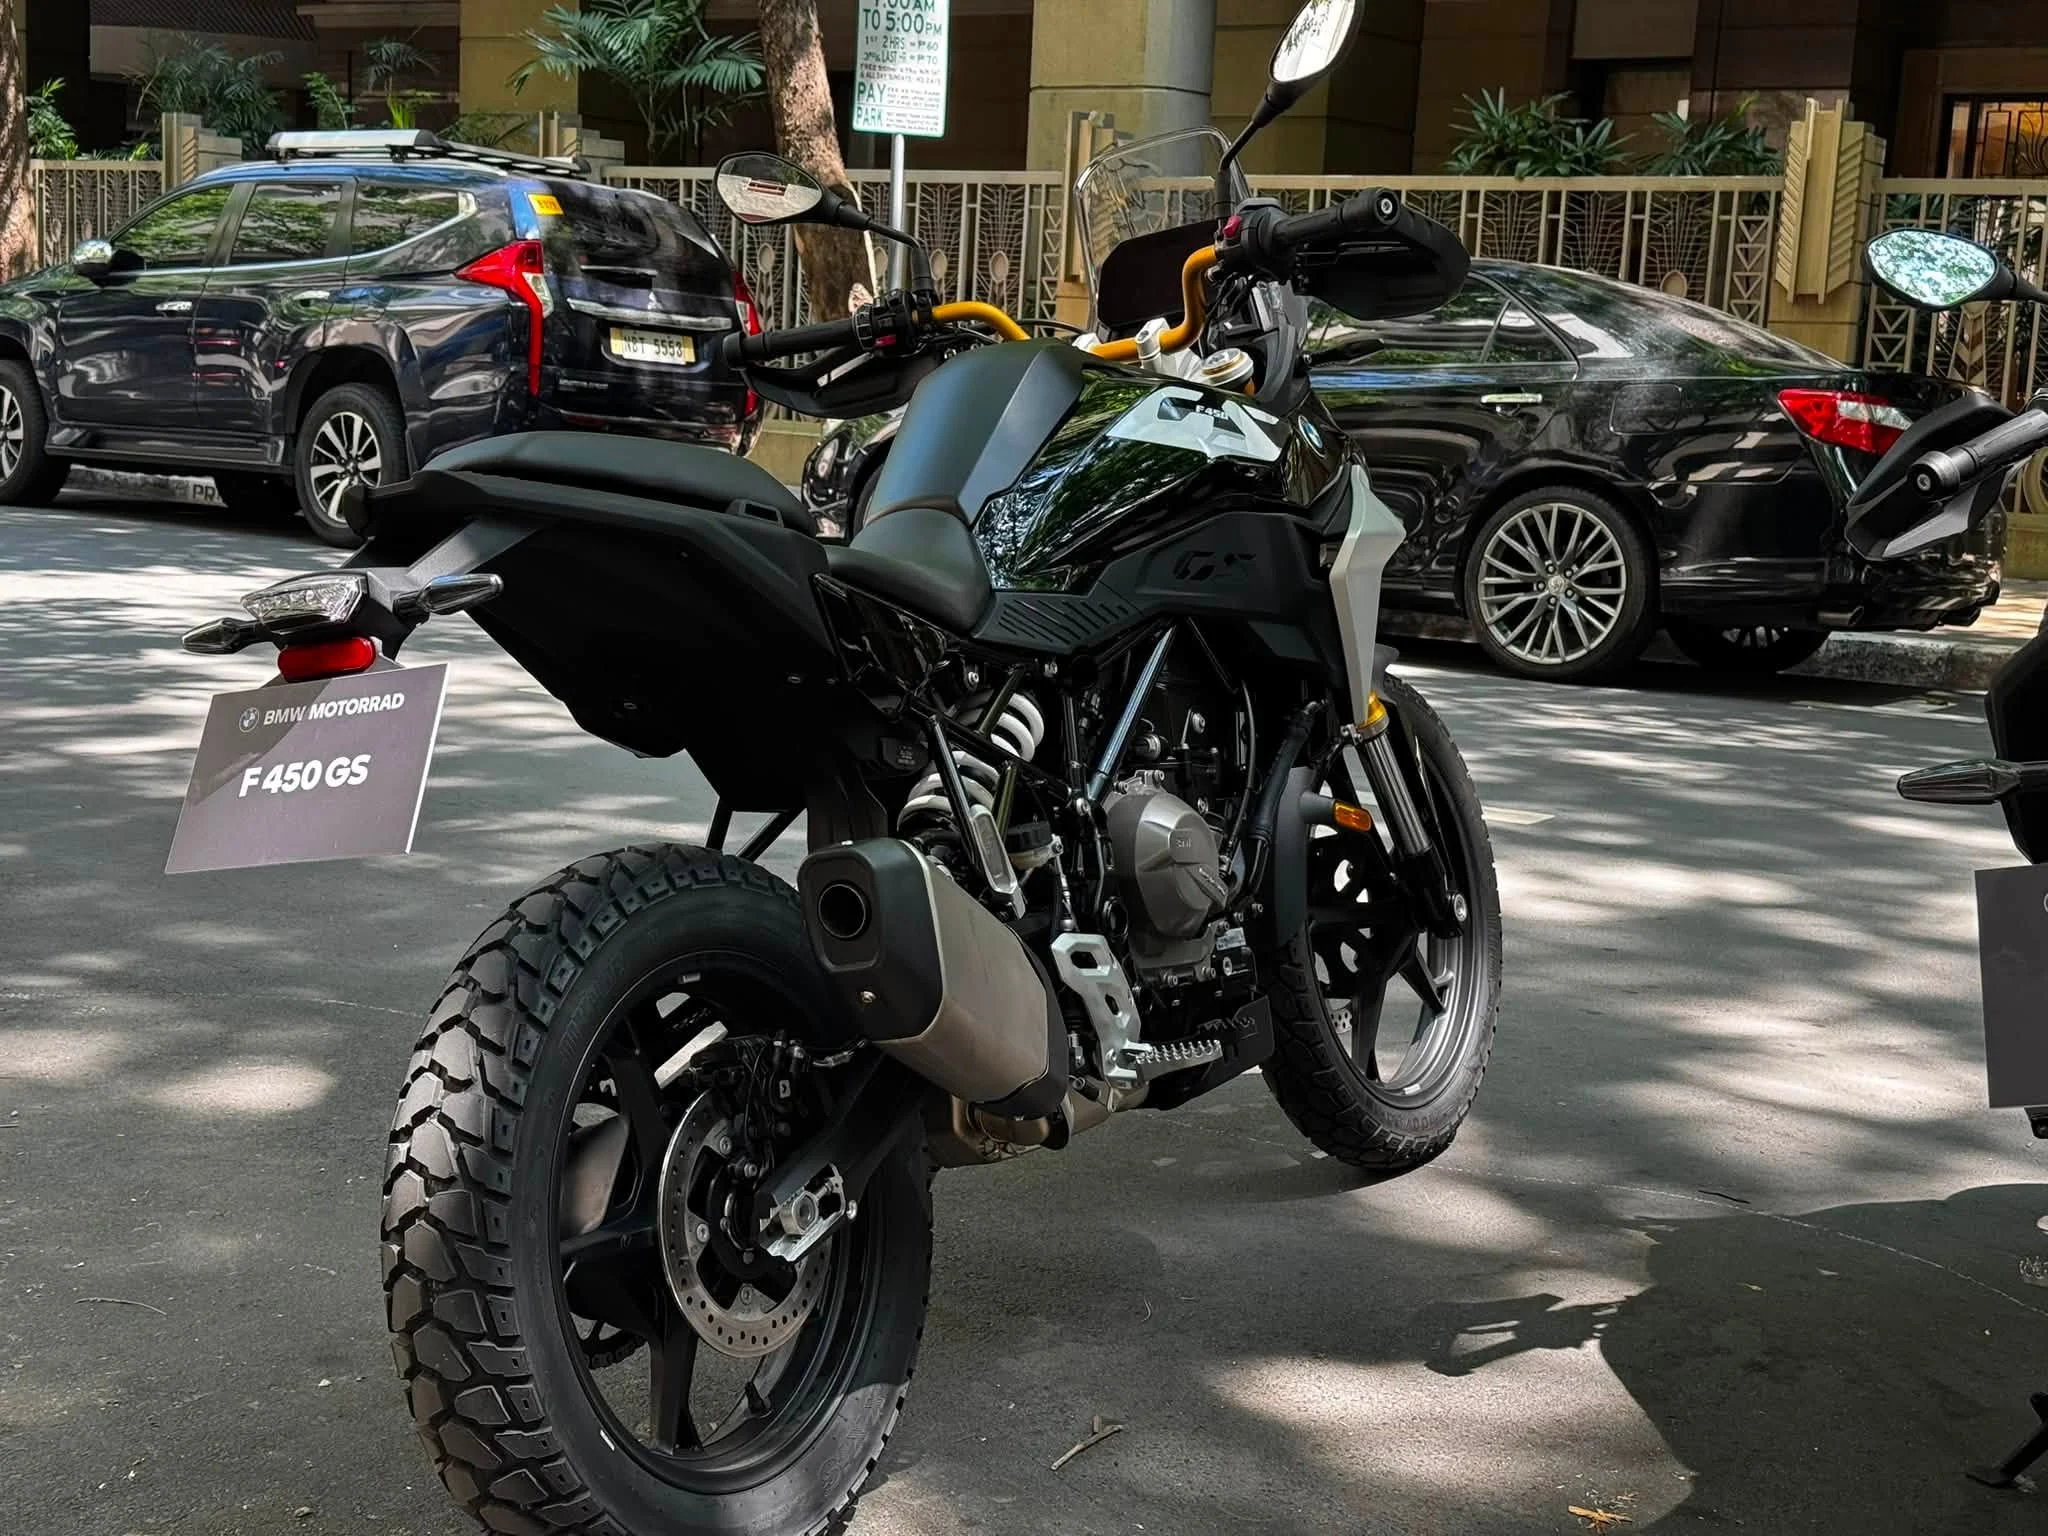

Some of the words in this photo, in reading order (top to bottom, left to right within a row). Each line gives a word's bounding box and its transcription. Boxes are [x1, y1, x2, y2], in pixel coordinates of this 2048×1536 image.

[863, 8, 880, 30] TO
[857, 81, 886, 103] PAY
[856, 106, 883, 127] PARK
[192, 484, 219, 501] PR
[264, 705, 306, 725] BMW
[308, 693, 405, 721] MOTORRAD
[238, 767, 262, 799] F
[261, 758, 323, 795] 450
[325, 754, 371, 788] GS
